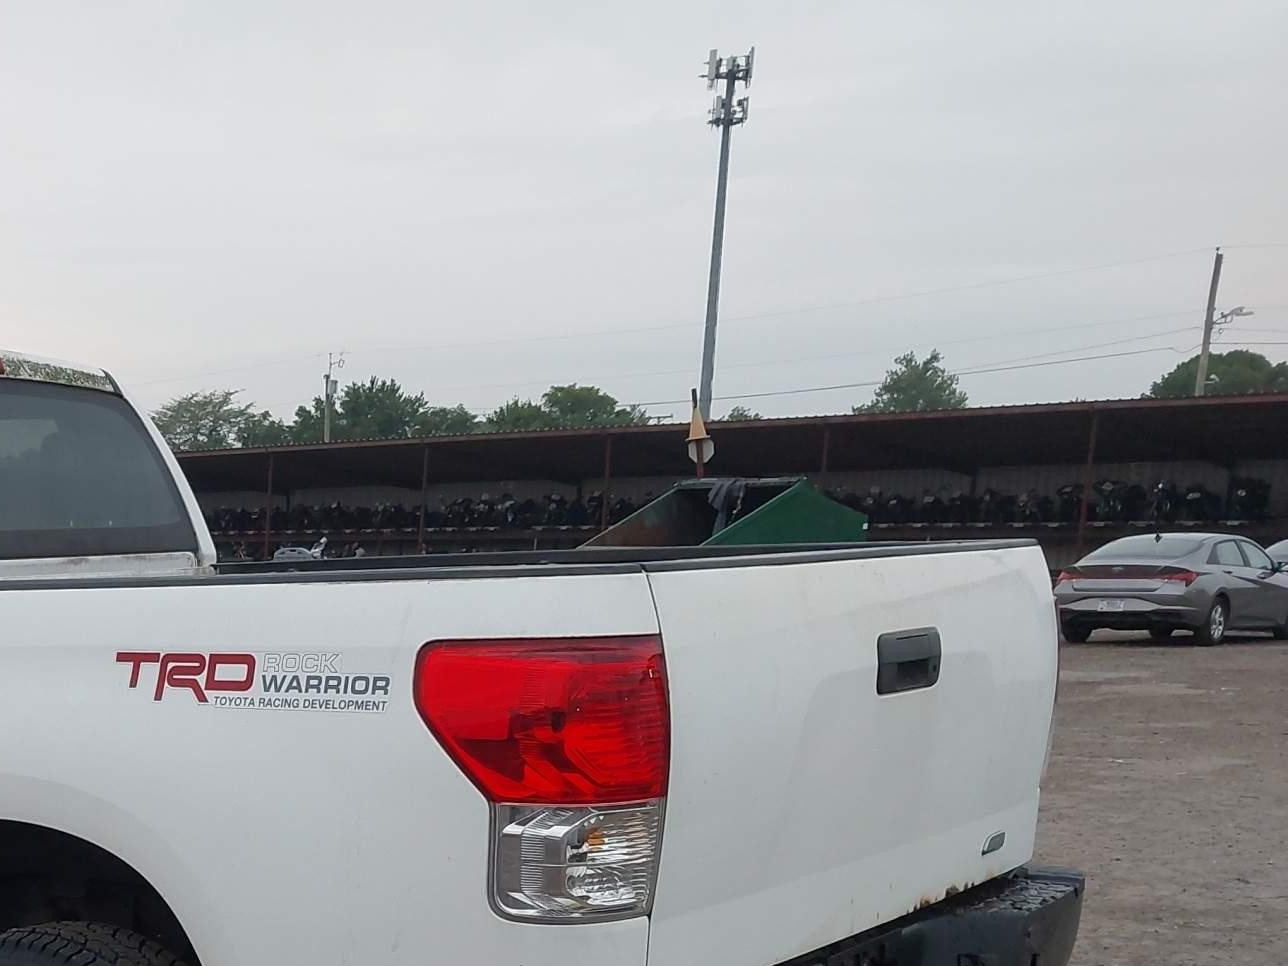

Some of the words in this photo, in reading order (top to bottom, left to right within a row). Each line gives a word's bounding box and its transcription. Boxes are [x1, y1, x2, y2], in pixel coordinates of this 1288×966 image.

[262, 652, 340, 674] ROCK
[115, 651, 257, 703] TRD
[261, 674, 391, 696] WARRIOR
[213, 695, 256, 708] TOYOTA
[258, 697, 300, 709] RACING
[302, 699, 388, 712] DEVELOPMENT
